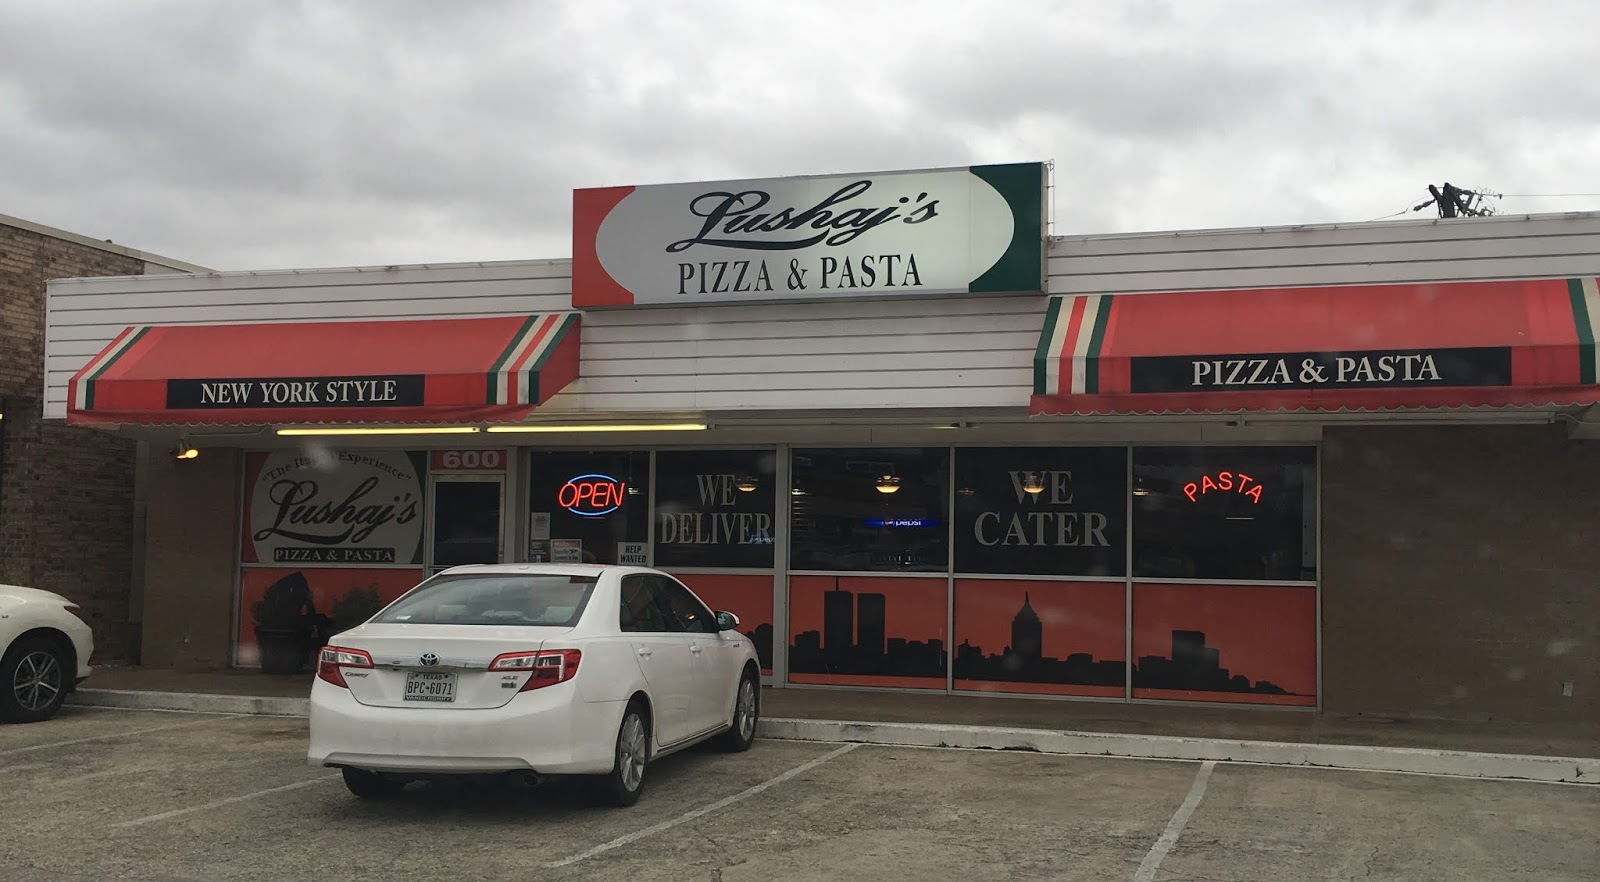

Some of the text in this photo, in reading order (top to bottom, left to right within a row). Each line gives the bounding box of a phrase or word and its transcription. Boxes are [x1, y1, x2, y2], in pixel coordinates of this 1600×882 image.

[665, 180, 940, 253] Lushaj's
[678, 253, 923, 295] PIZZA & PASTA
[1191, 355, 1442, 386] PIZZA & PASTA
[200, 380, 397, 403] NEW YORK STYLE
[293, 451, 334, 468] Itan
[442, 450, 500, 468] 600
[558, 482, 625, 508] OPEN
[696, 474, 737, 506] WE
[1008, 470, 1073, 505] WE
[1183, 471, 1263, 504] PASTA
[253, 476, 417, 545] Lushaj's
[660, 512, 772, 545] DELIVER
[974, 511, 1111, 547] CATER
[275, 549, 393, 561] PIZZA & PASTA
[620, 555, 647, 563] WANTED
[625, 545, 642, 553] HELP
